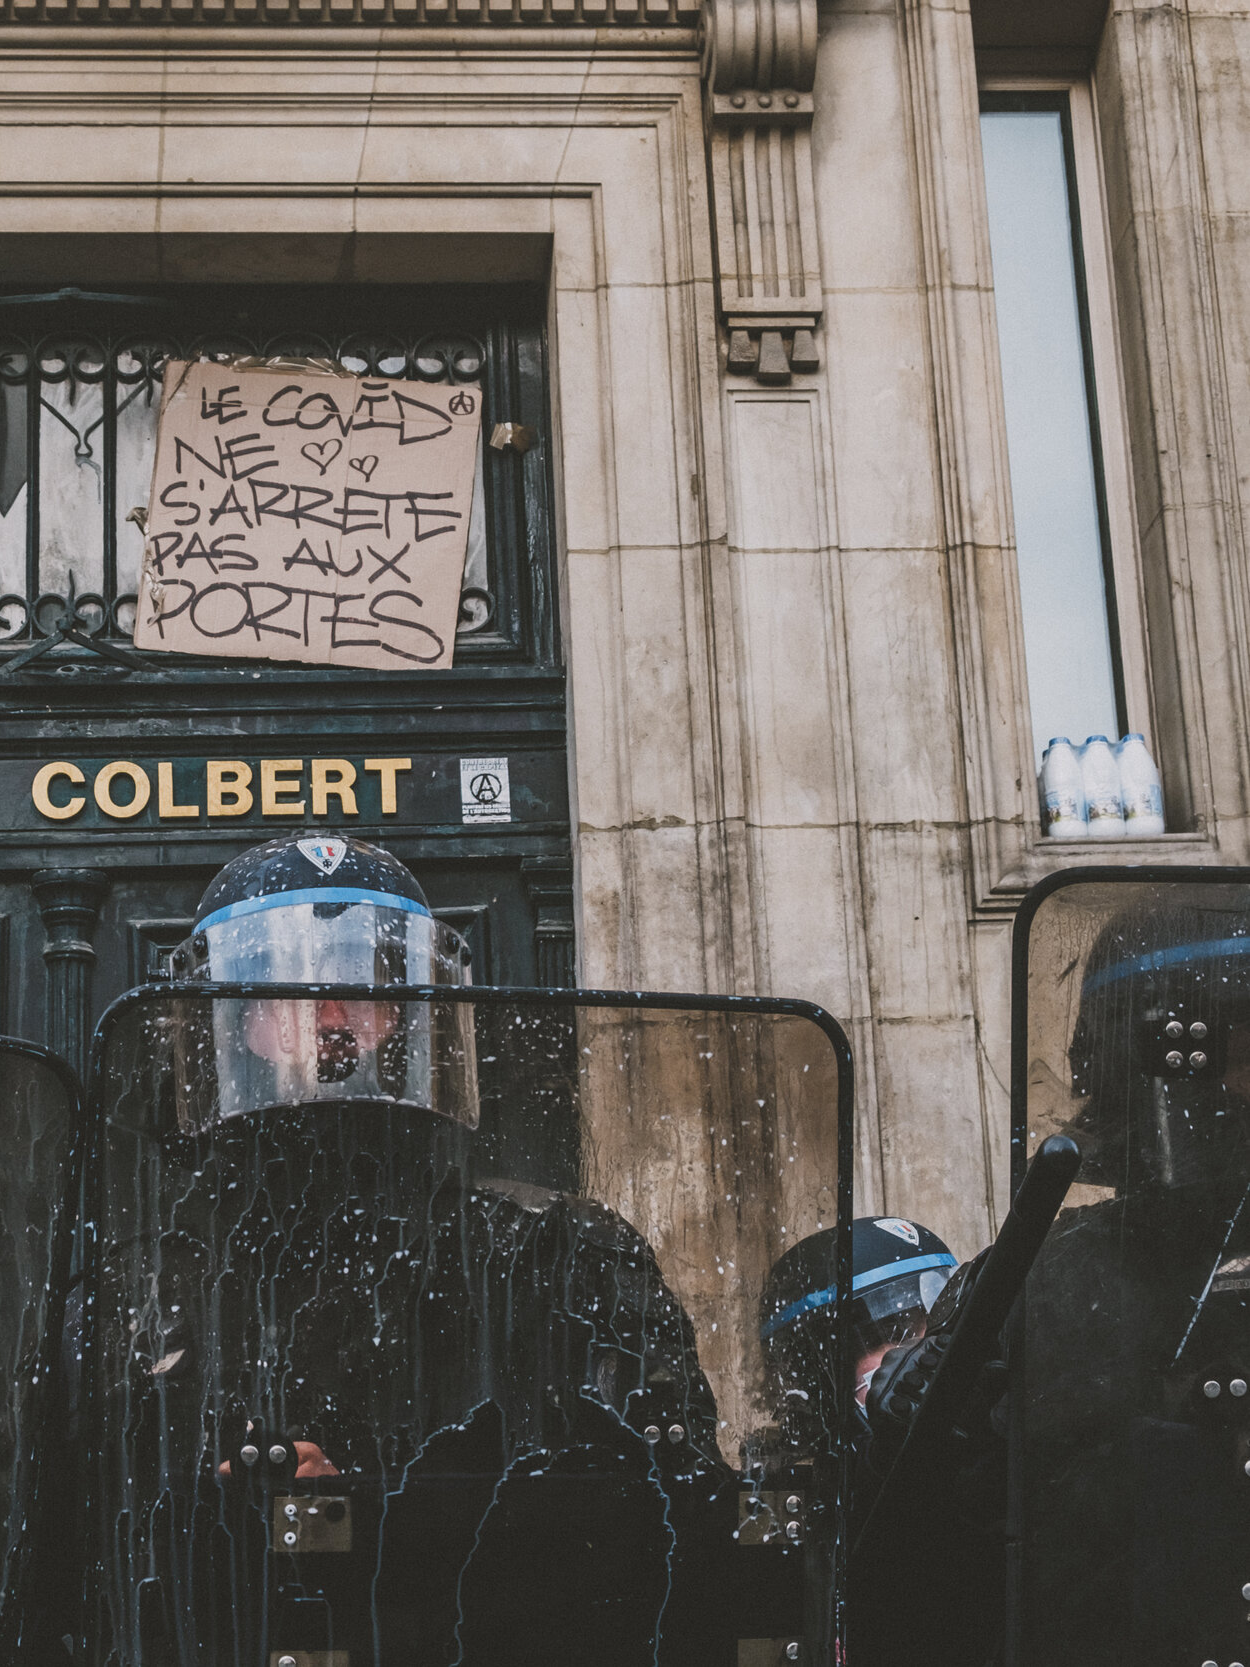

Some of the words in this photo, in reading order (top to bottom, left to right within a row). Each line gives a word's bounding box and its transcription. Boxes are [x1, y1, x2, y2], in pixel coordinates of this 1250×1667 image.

[201, 385, 247, 425] LE
[262, 382, 453, 446] COVID
[174, 433, 279, 480] NE
[159, 478, 462, 542] S'ARRETE
[150, 531, 259, 576] PAS
[283, 538, 411, 584] AUX
[147, 580, 445, 665] PORTES
[31, 757, 412, 821] COLBERT
